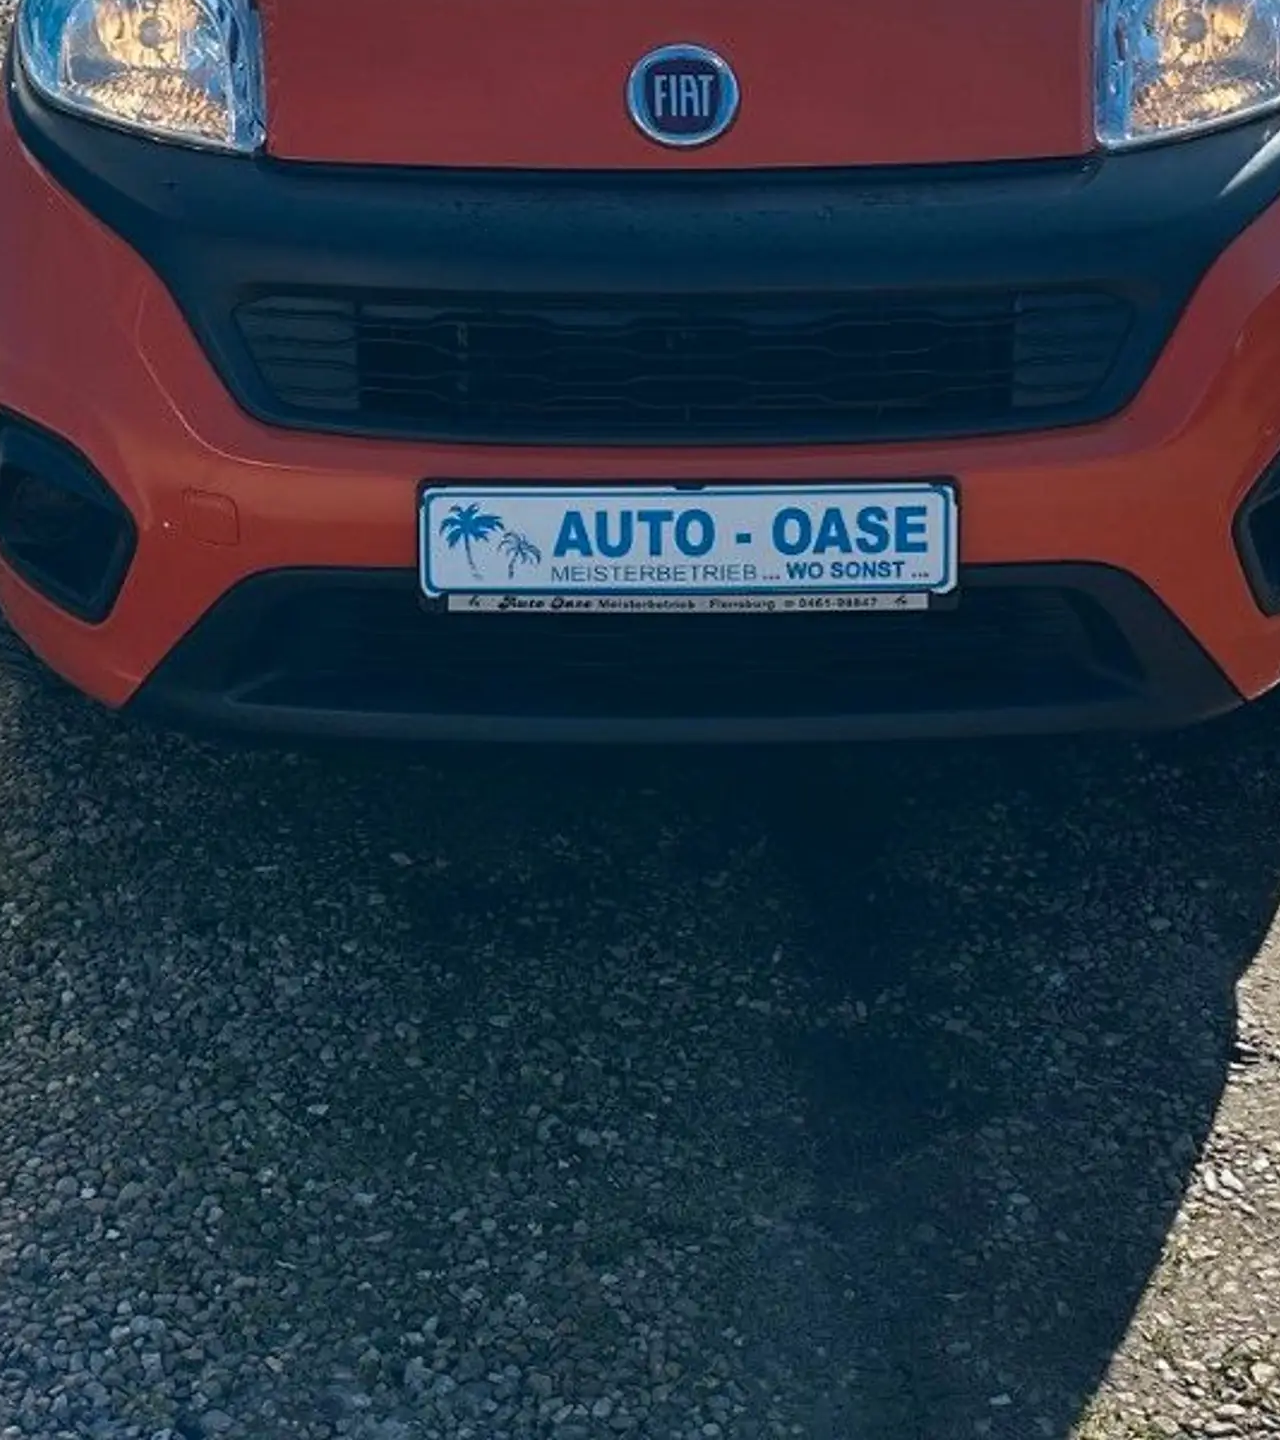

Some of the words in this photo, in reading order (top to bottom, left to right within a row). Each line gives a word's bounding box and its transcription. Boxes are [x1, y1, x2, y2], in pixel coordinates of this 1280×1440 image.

[654, 74, 714, 117] FIAT
[554, 509, 715, 557] AUTO
[773, 506, 928, 555] OASE
[786, 561, 824, 580] WO
